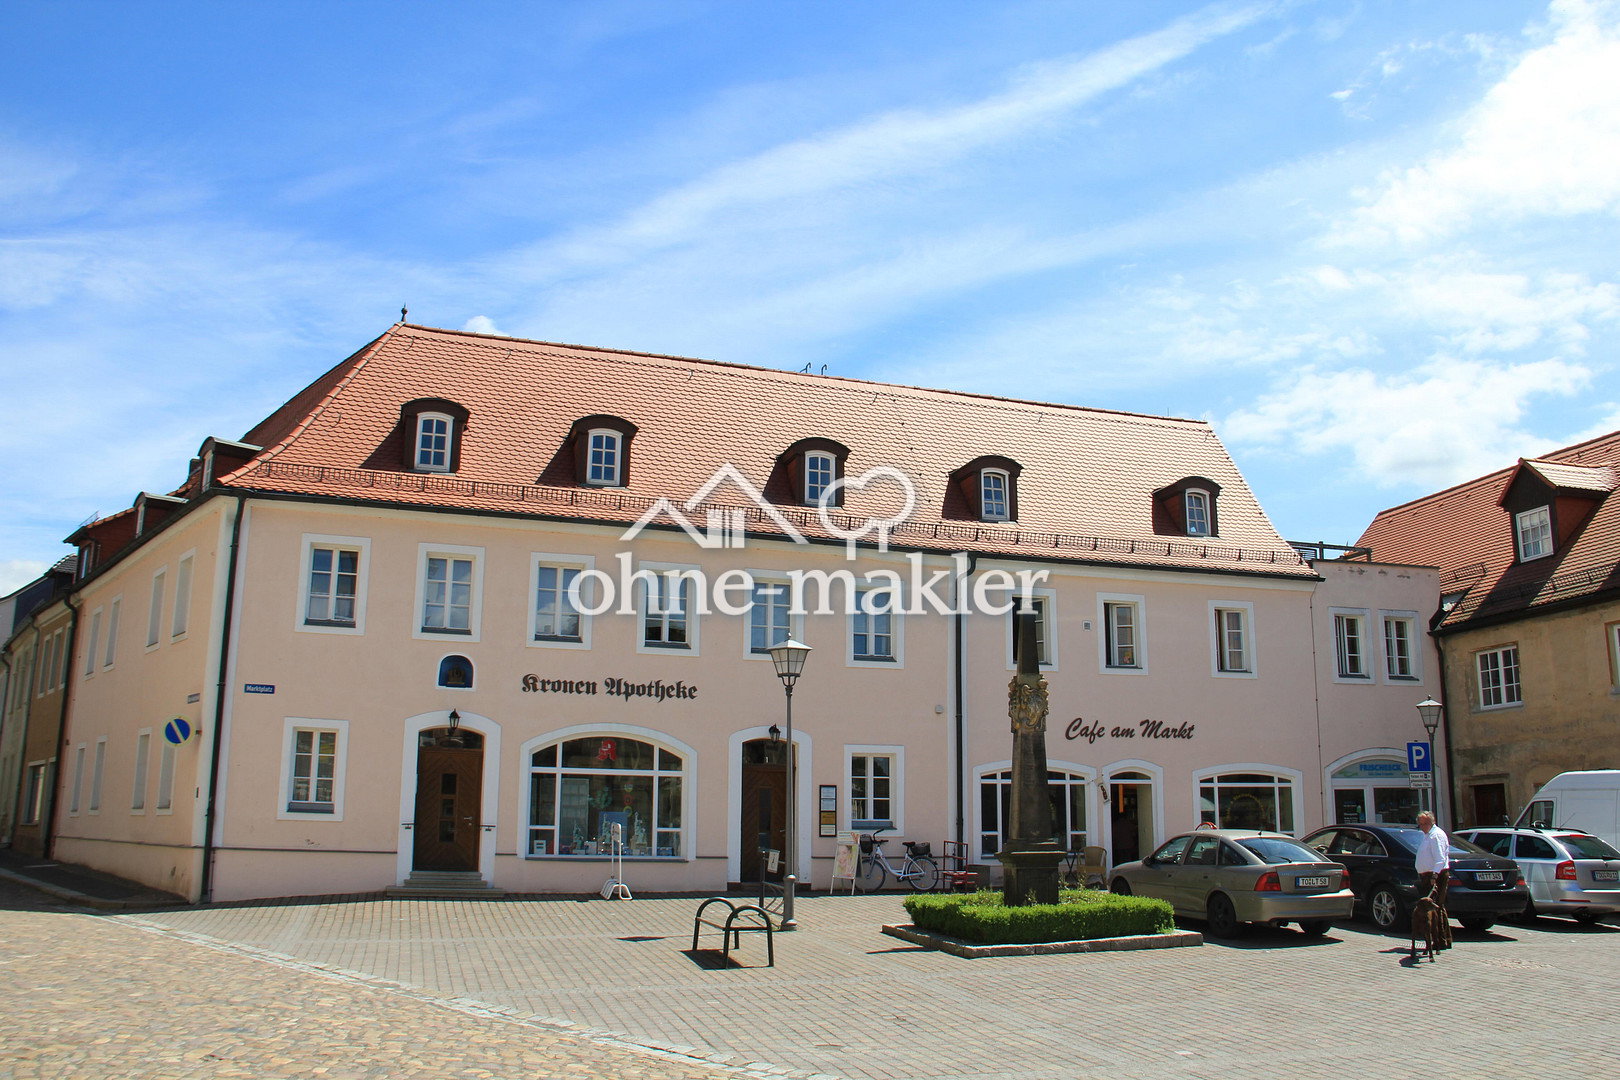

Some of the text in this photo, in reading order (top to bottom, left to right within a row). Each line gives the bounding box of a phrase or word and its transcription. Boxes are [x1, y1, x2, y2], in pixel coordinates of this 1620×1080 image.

[245, 685, 274, 693] Marktplatz
[522, 673, 698, 703] Kronen Apotheke
[1065, 717, 1195, 744] Cafe am Markt
[1411, 745, 1425, 769] P
